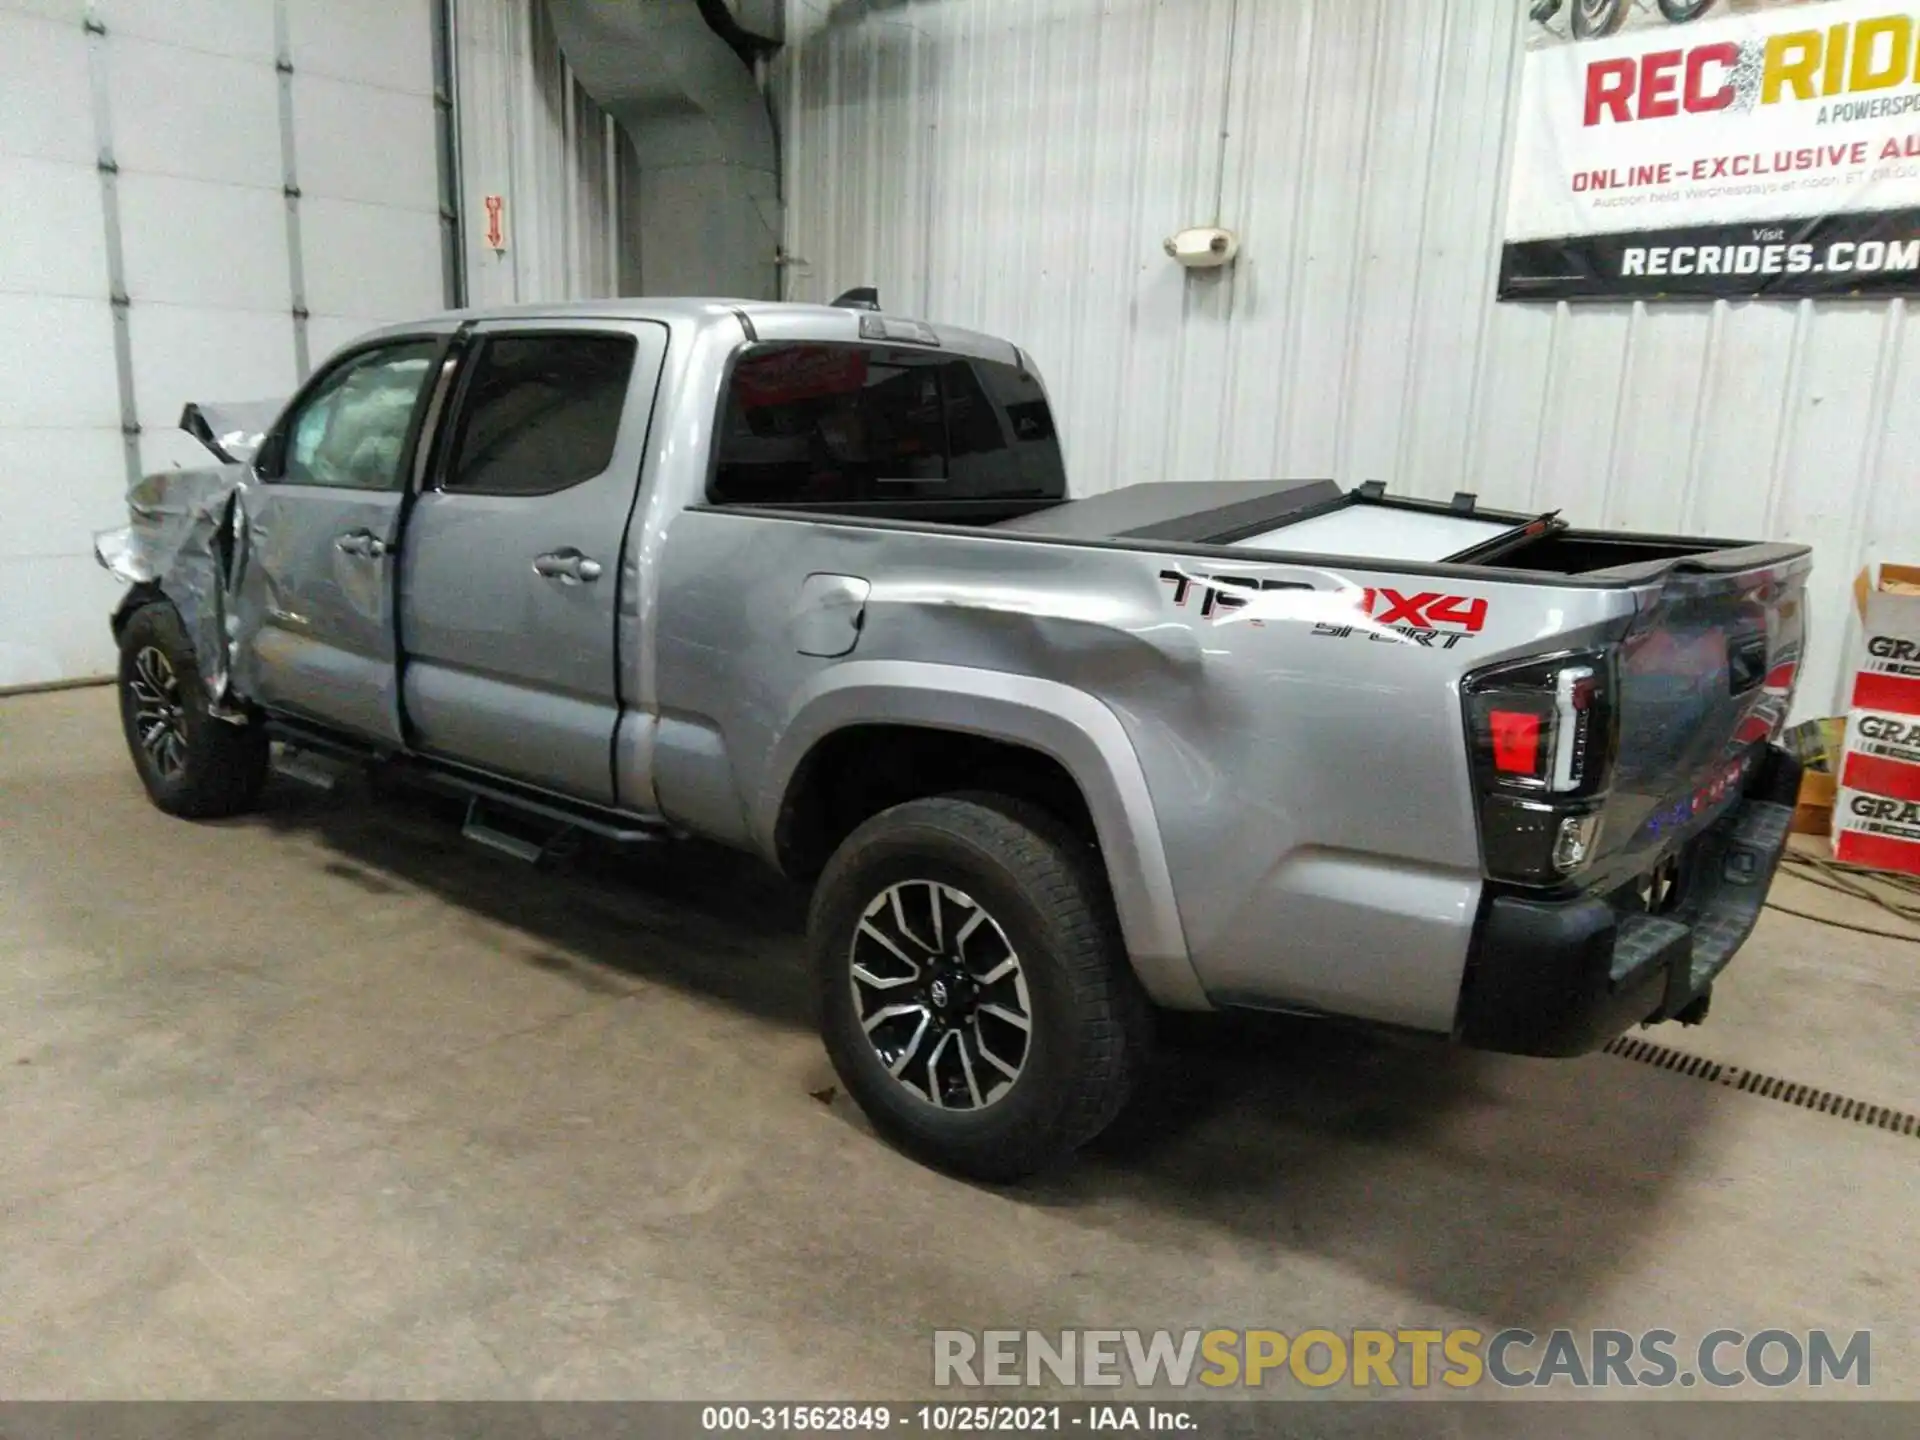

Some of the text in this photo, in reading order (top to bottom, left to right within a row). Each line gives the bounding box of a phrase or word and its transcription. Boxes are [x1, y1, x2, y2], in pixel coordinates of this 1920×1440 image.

[1583, 13, 1920, 127] REC RID
[1816, 105, 1828, 126] A
[1571, 141, 1868, 193] ONLINE-EXCLUSIVE
[1592, 195, 1646, 209] Auction
[1650, 189, 1680, 204] held
[1685, 182, 1777, 201] Wednesdays
[1752, 227, 1785, 242] Visit
[1621, 239, 1920, 276] RECRIDES.COM
